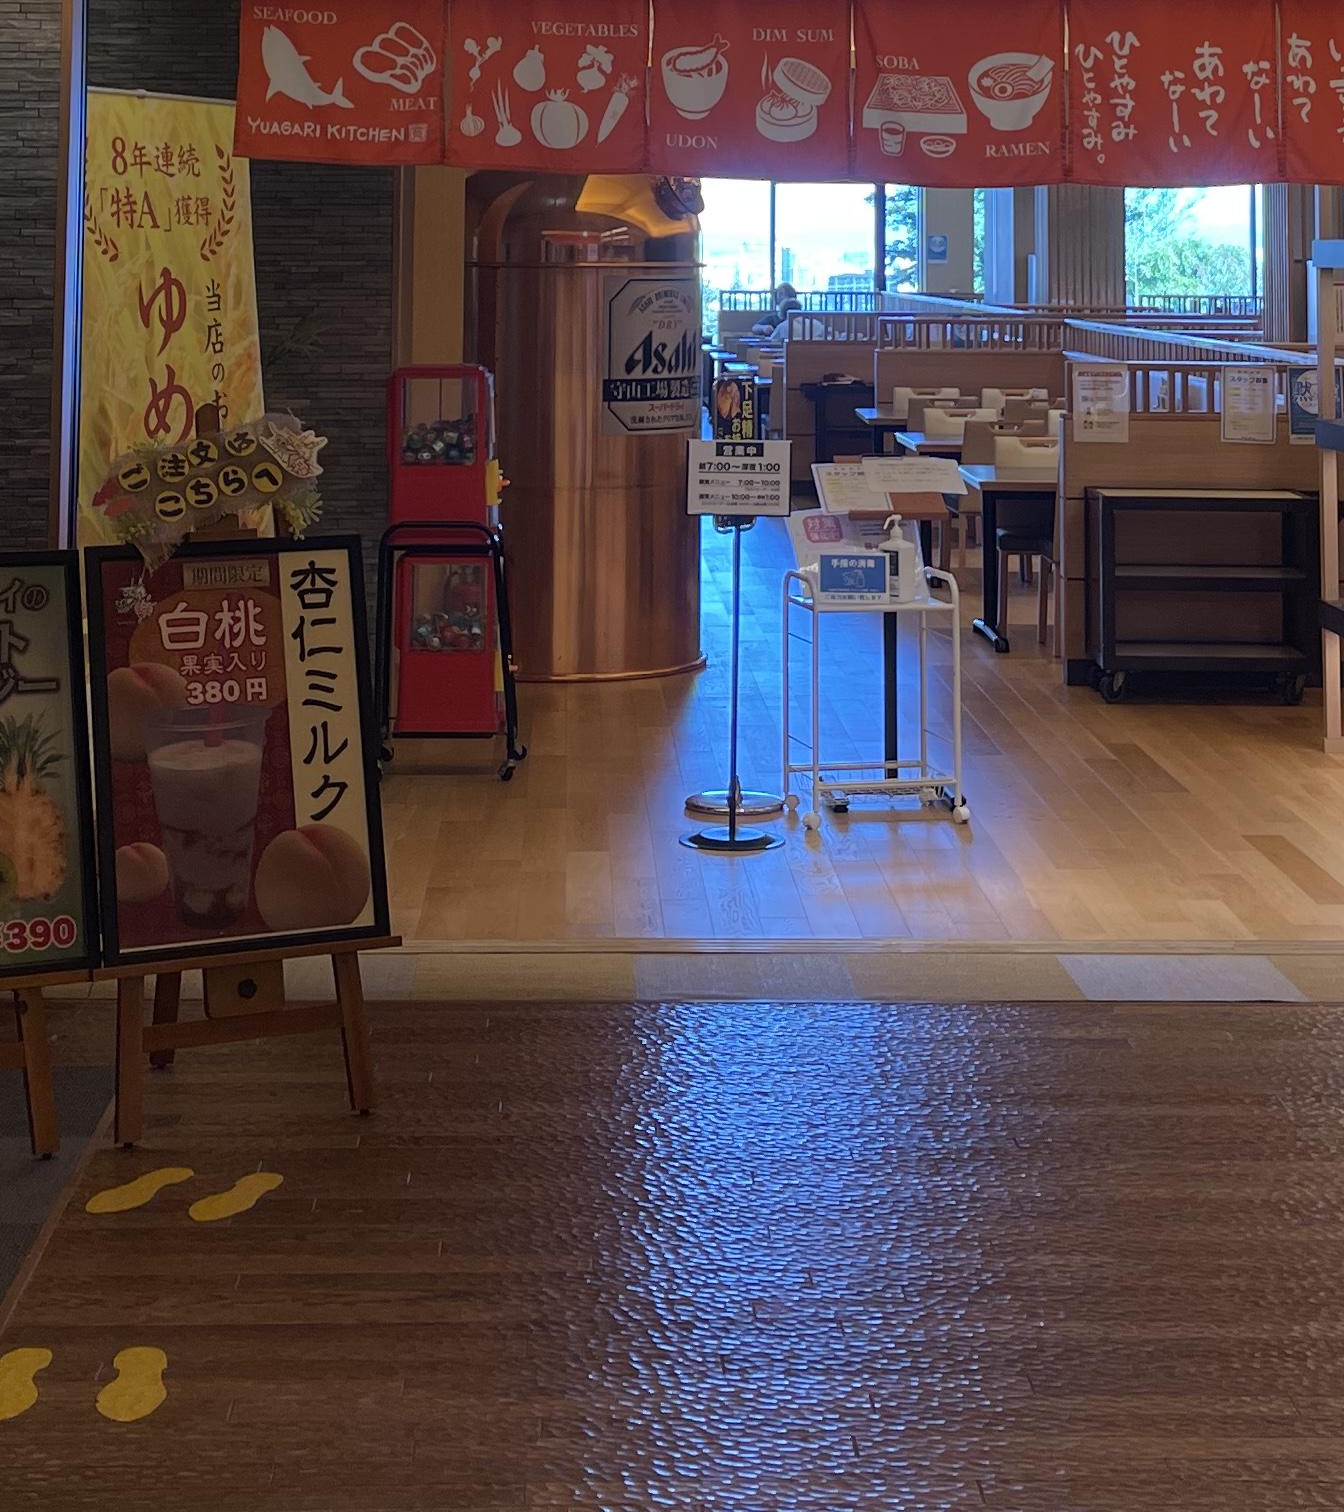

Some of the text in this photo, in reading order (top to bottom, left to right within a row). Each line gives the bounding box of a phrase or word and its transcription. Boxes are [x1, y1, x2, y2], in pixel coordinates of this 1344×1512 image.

[252, 6, 338, 26] SEAFOOD
[530, 20, 639, 39] VEGETABLES
[752, 27, 835, 44] DIM SUM
[875, 53, 920, 71] SOBA
[1106, 31, 1140, 142] ひとやすみ
[1191, 41, 1226, 137] あわて
[1287, 33, 1318, 124] あわて
[389, 97, 438, 113] MEAT
[247, 117, 405, 143] YUAGARI KITCHEN
[665, 133, 719, 151] UDON
[111, 136, 201, 178] 8年連続
[984, 141, 1051, 159] RAMEN
[138, 266, 197, 446] ゆめ
[156, 465, 283, 519] こちらへ
[157, 599, 267, 652] 白桃
[179, 653, 267, 676] 果実入り
[186, 677, 269, 706] 380円
[289, 559, 349, 821] 杏仁ミルク
